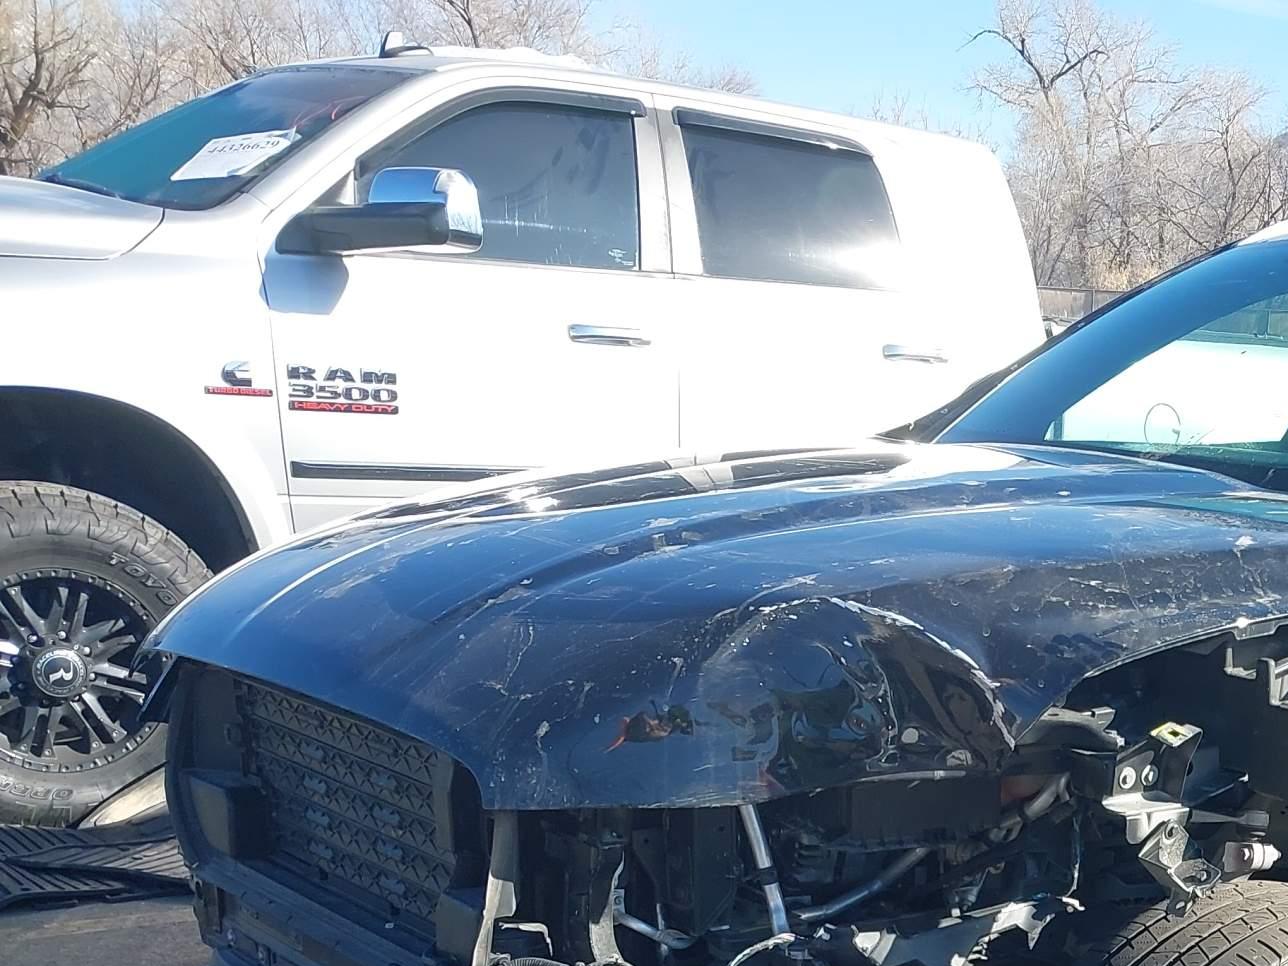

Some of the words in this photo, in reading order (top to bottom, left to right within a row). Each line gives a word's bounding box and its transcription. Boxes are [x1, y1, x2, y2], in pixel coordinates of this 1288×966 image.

[287, 363, 397, 386] RAM
[288, 382, 398, 403] 3500
[294, 401, 349, 412] HEAVY
[351, 403, 396, 414] DUTY
[109, 551, 178, 607] TOYO
